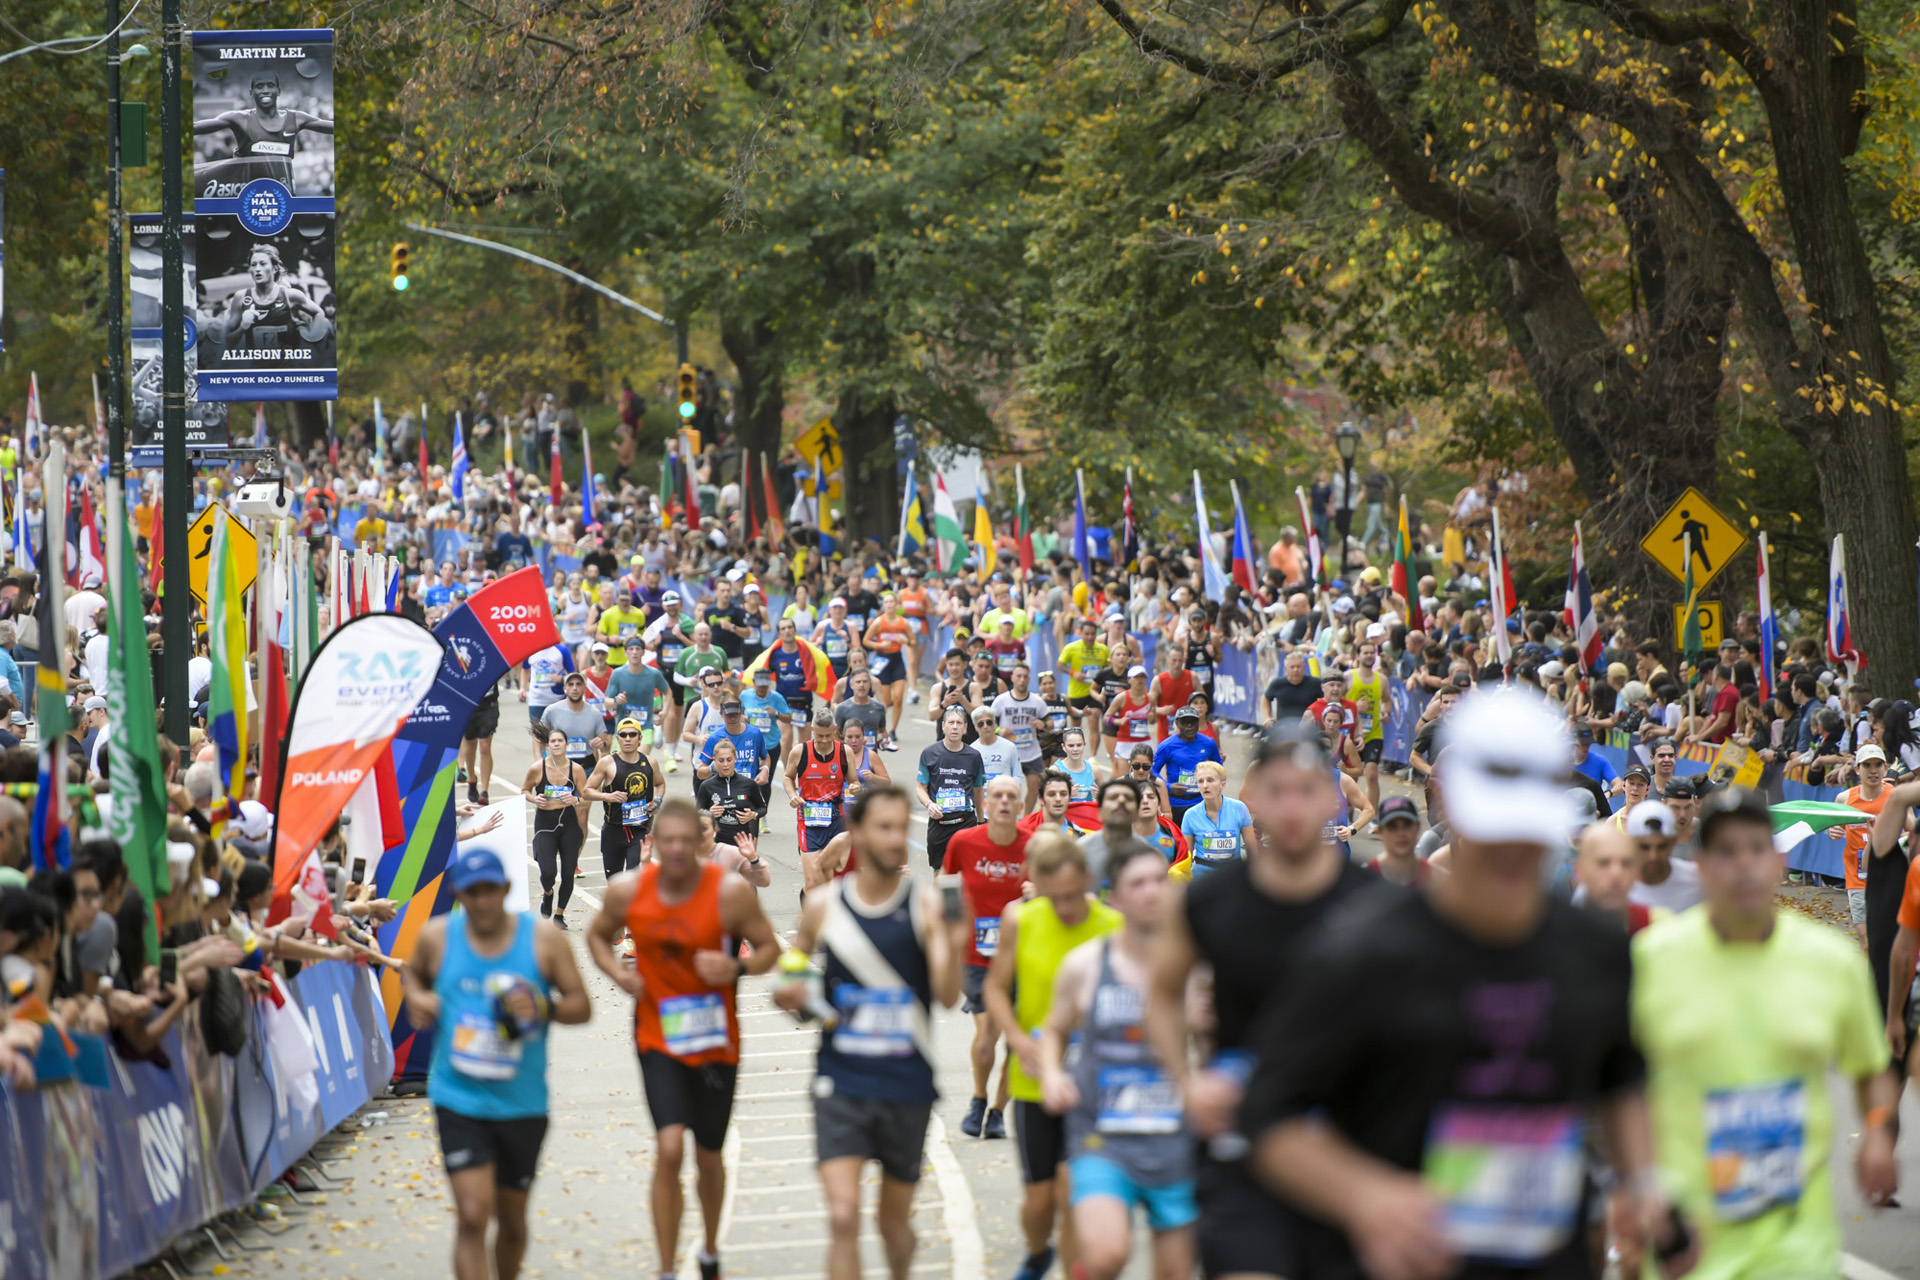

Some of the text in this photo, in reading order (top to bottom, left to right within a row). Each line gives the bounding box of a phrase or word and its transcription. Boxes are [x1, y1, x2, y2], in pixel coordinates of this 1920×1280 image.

[220, 47, 306, 60] MARTIN LEL
[251, 198, 278, 206] HALL
[251, 208, 278, 216] FAME
[221, 348, 312, 361] ALLISON ROE
[232, 376, 256, 384] YORK
[284, 375, 325, 383] RUNNERS
[490, 604, 541, 620] 200M
[497, 622, 536, 634] TO GO
[1004, 706, 1019, 716] NEW
[1011, 715, 1030, 725] CITY
[735, 749, 755, 759] ANCE
[990, 754, 1002, 763] 22
[291, 768, 364, 787] POLAND
[1216, 839, 1233, 849] 13129
